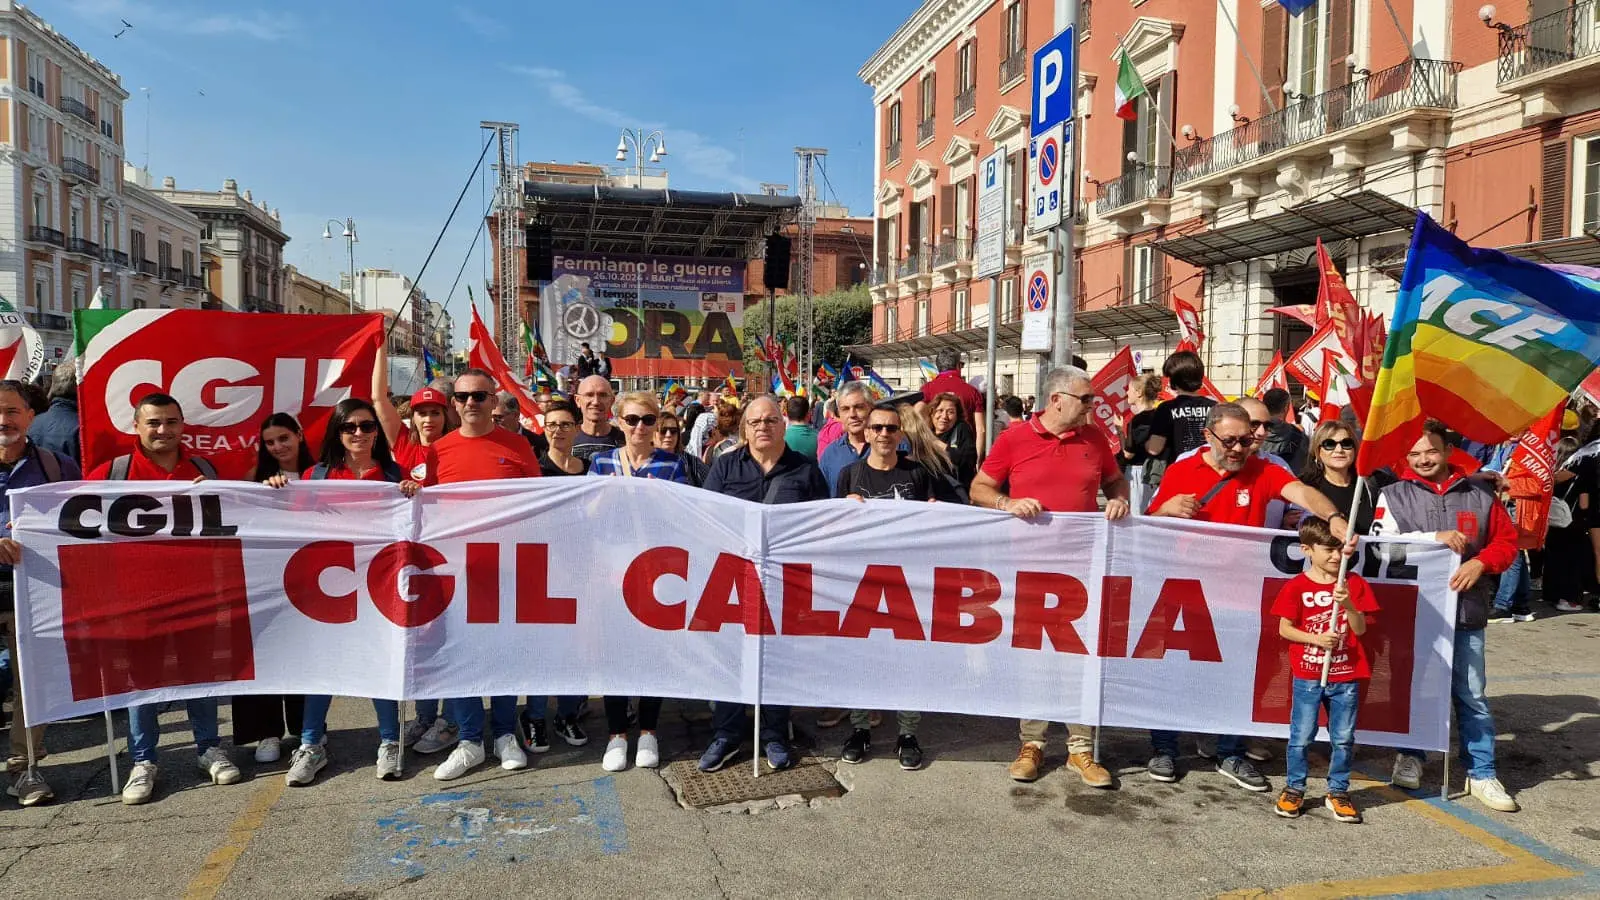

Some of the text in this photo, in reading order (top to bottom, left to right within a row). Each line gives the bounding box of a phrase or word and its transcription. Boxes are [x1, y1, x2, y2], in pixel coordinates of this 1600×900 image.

[1038, 48, 1063, 124] P
[987, 162, 994, 186] P
[1037, 199, 1044, 214] P
[553, 255, 732, 278] Fermiamo le guerre
[593, 272, 643, 281] 26.10.2024
[594, 289, 638, 299] il tempo
[643, 301, 667, 309] Pace
[600, 308, 743, 360] ORA
[105, 357, 352, 435] CGIL
[1171, 406, 1210, 420] KASABIA
[58, 494, 239, 540] CGIL
[284, 539, 577, 629] CGIL
[622, 545, 1223, 664] CALABRIA
